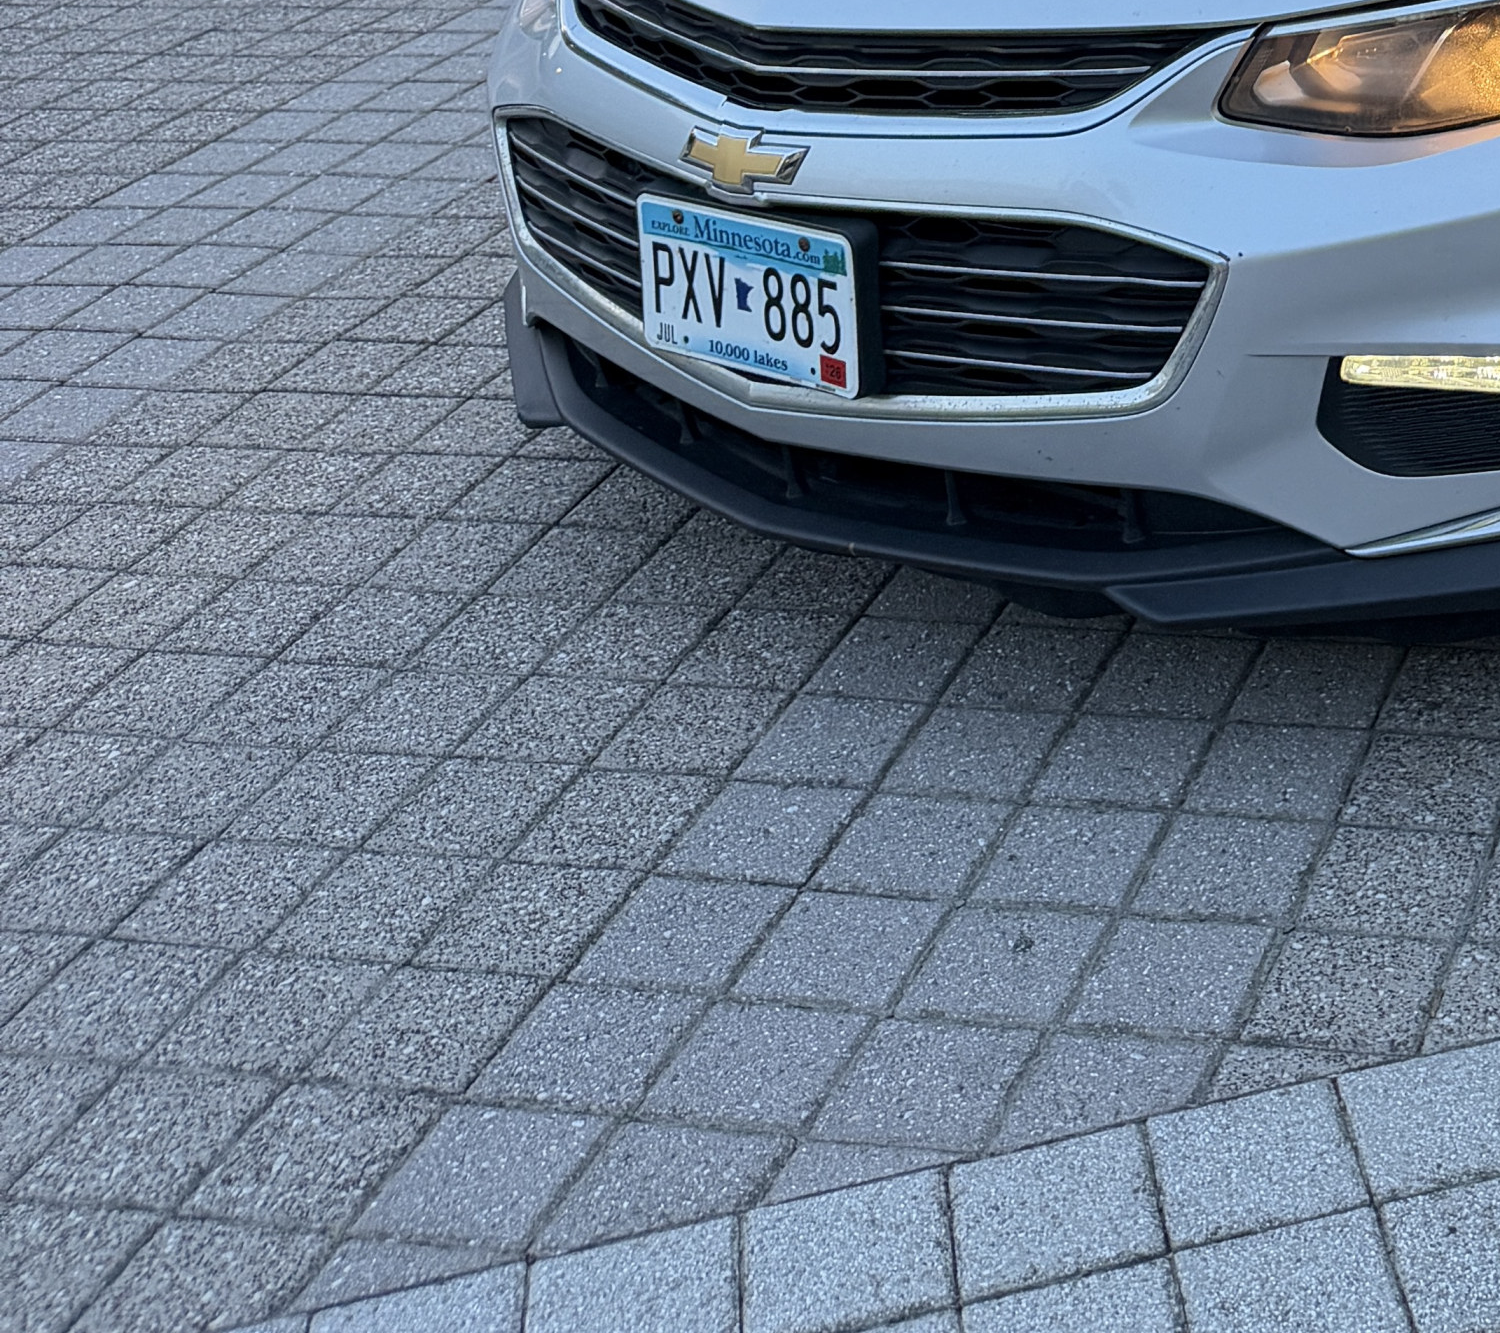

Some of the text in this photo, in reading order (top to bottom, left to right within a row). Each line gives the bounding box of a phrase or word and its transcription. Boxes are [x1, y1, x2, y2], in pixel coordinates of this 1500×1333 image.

[652, 241, 841, 355] PXV 885
[656, 322, 678, 345] JUL
[708, 338, 788, 371] 10,000 lakes
